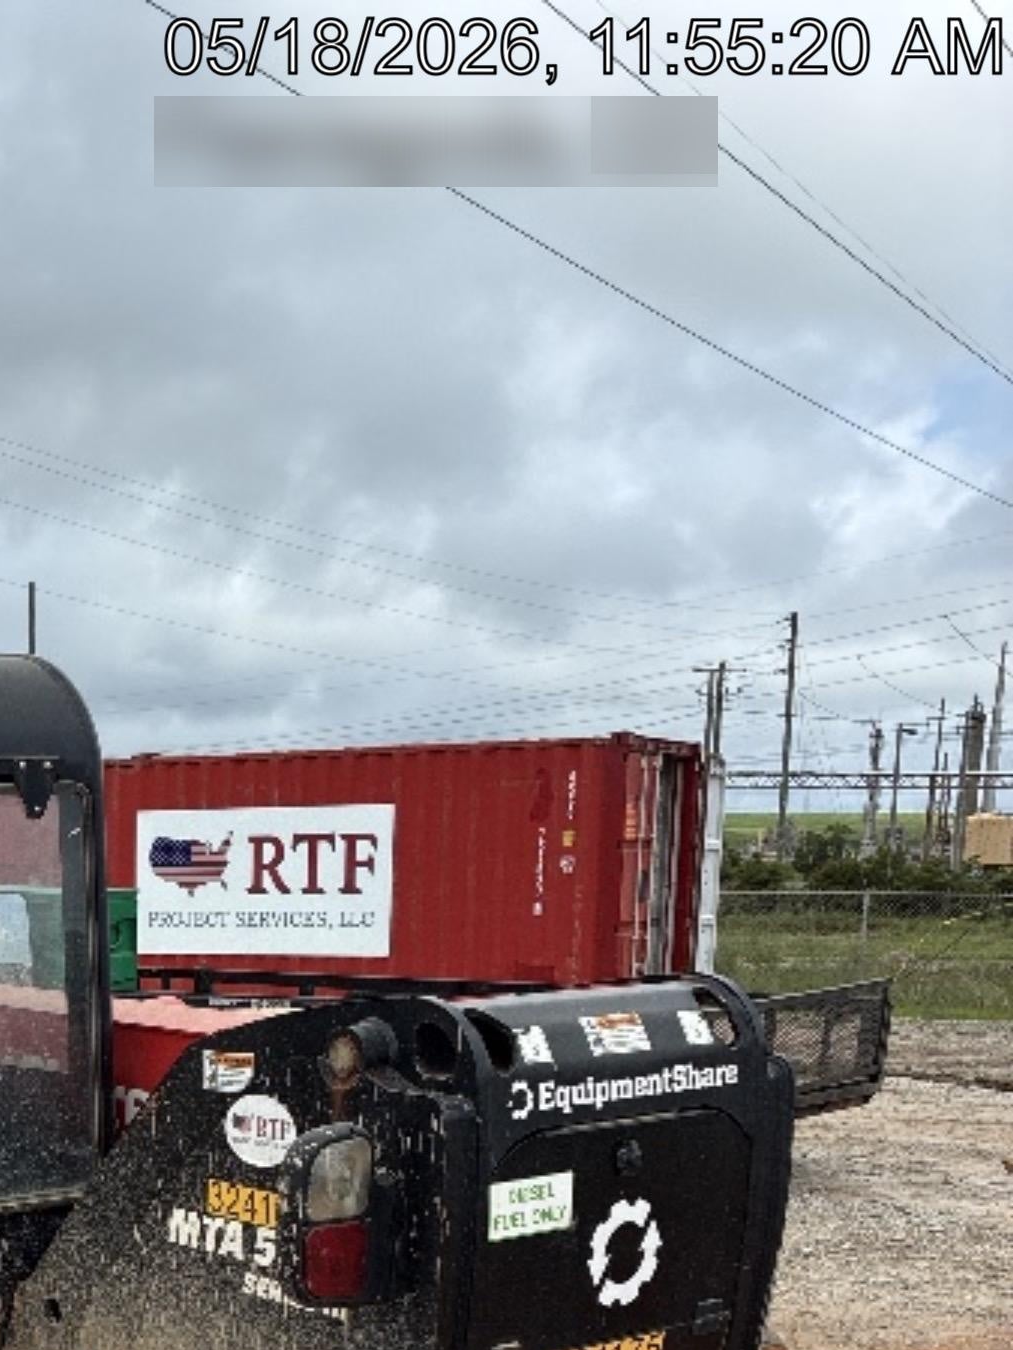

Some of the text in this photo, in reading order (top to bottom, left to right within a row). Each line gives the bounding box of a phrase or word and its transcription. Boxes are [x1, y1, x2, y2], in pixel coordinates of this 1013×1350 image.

[245, 832, 378, 895] RTF
[148, 911, 376, 931] PROJECT SERVICES, LLC
[538, 1063, 738, 1114] EquipmentShare
[209, 1181, 280, 1226] 3241
[168, 1206, 278, 1268] MTA 5
